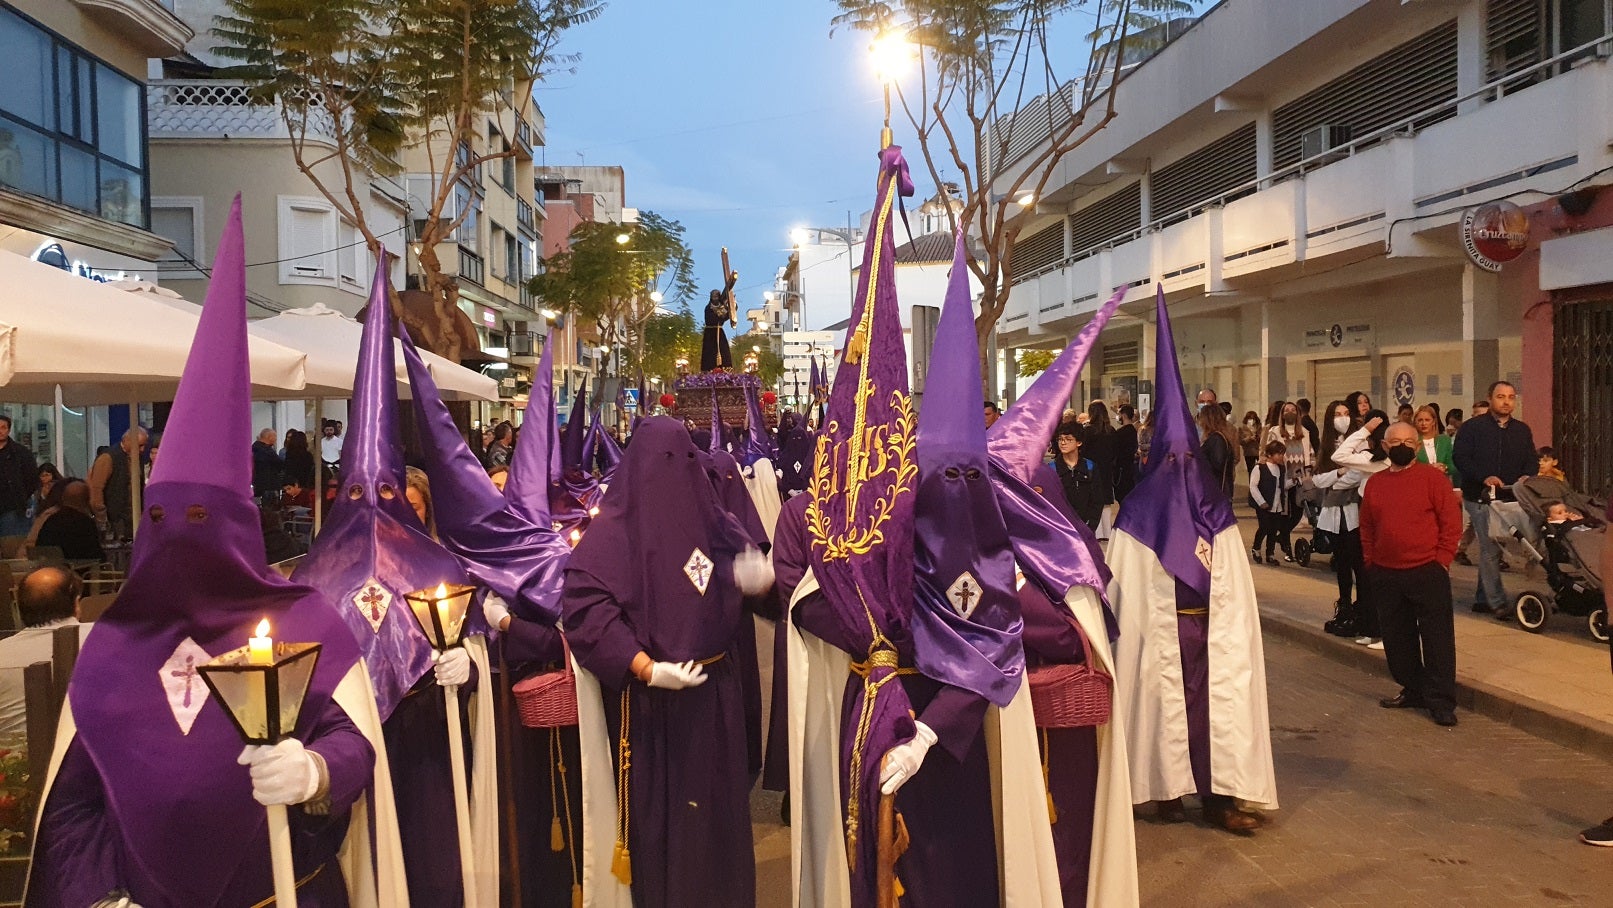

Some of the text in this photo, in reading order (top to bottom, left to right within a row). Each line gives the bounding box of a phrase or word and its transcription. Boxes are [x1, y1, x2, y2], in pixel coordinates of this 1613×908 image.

[1464, 216, 1499, 269] LA SIRENITA GUAY
[1479, 229, 1527, 242] Cruzcampo
